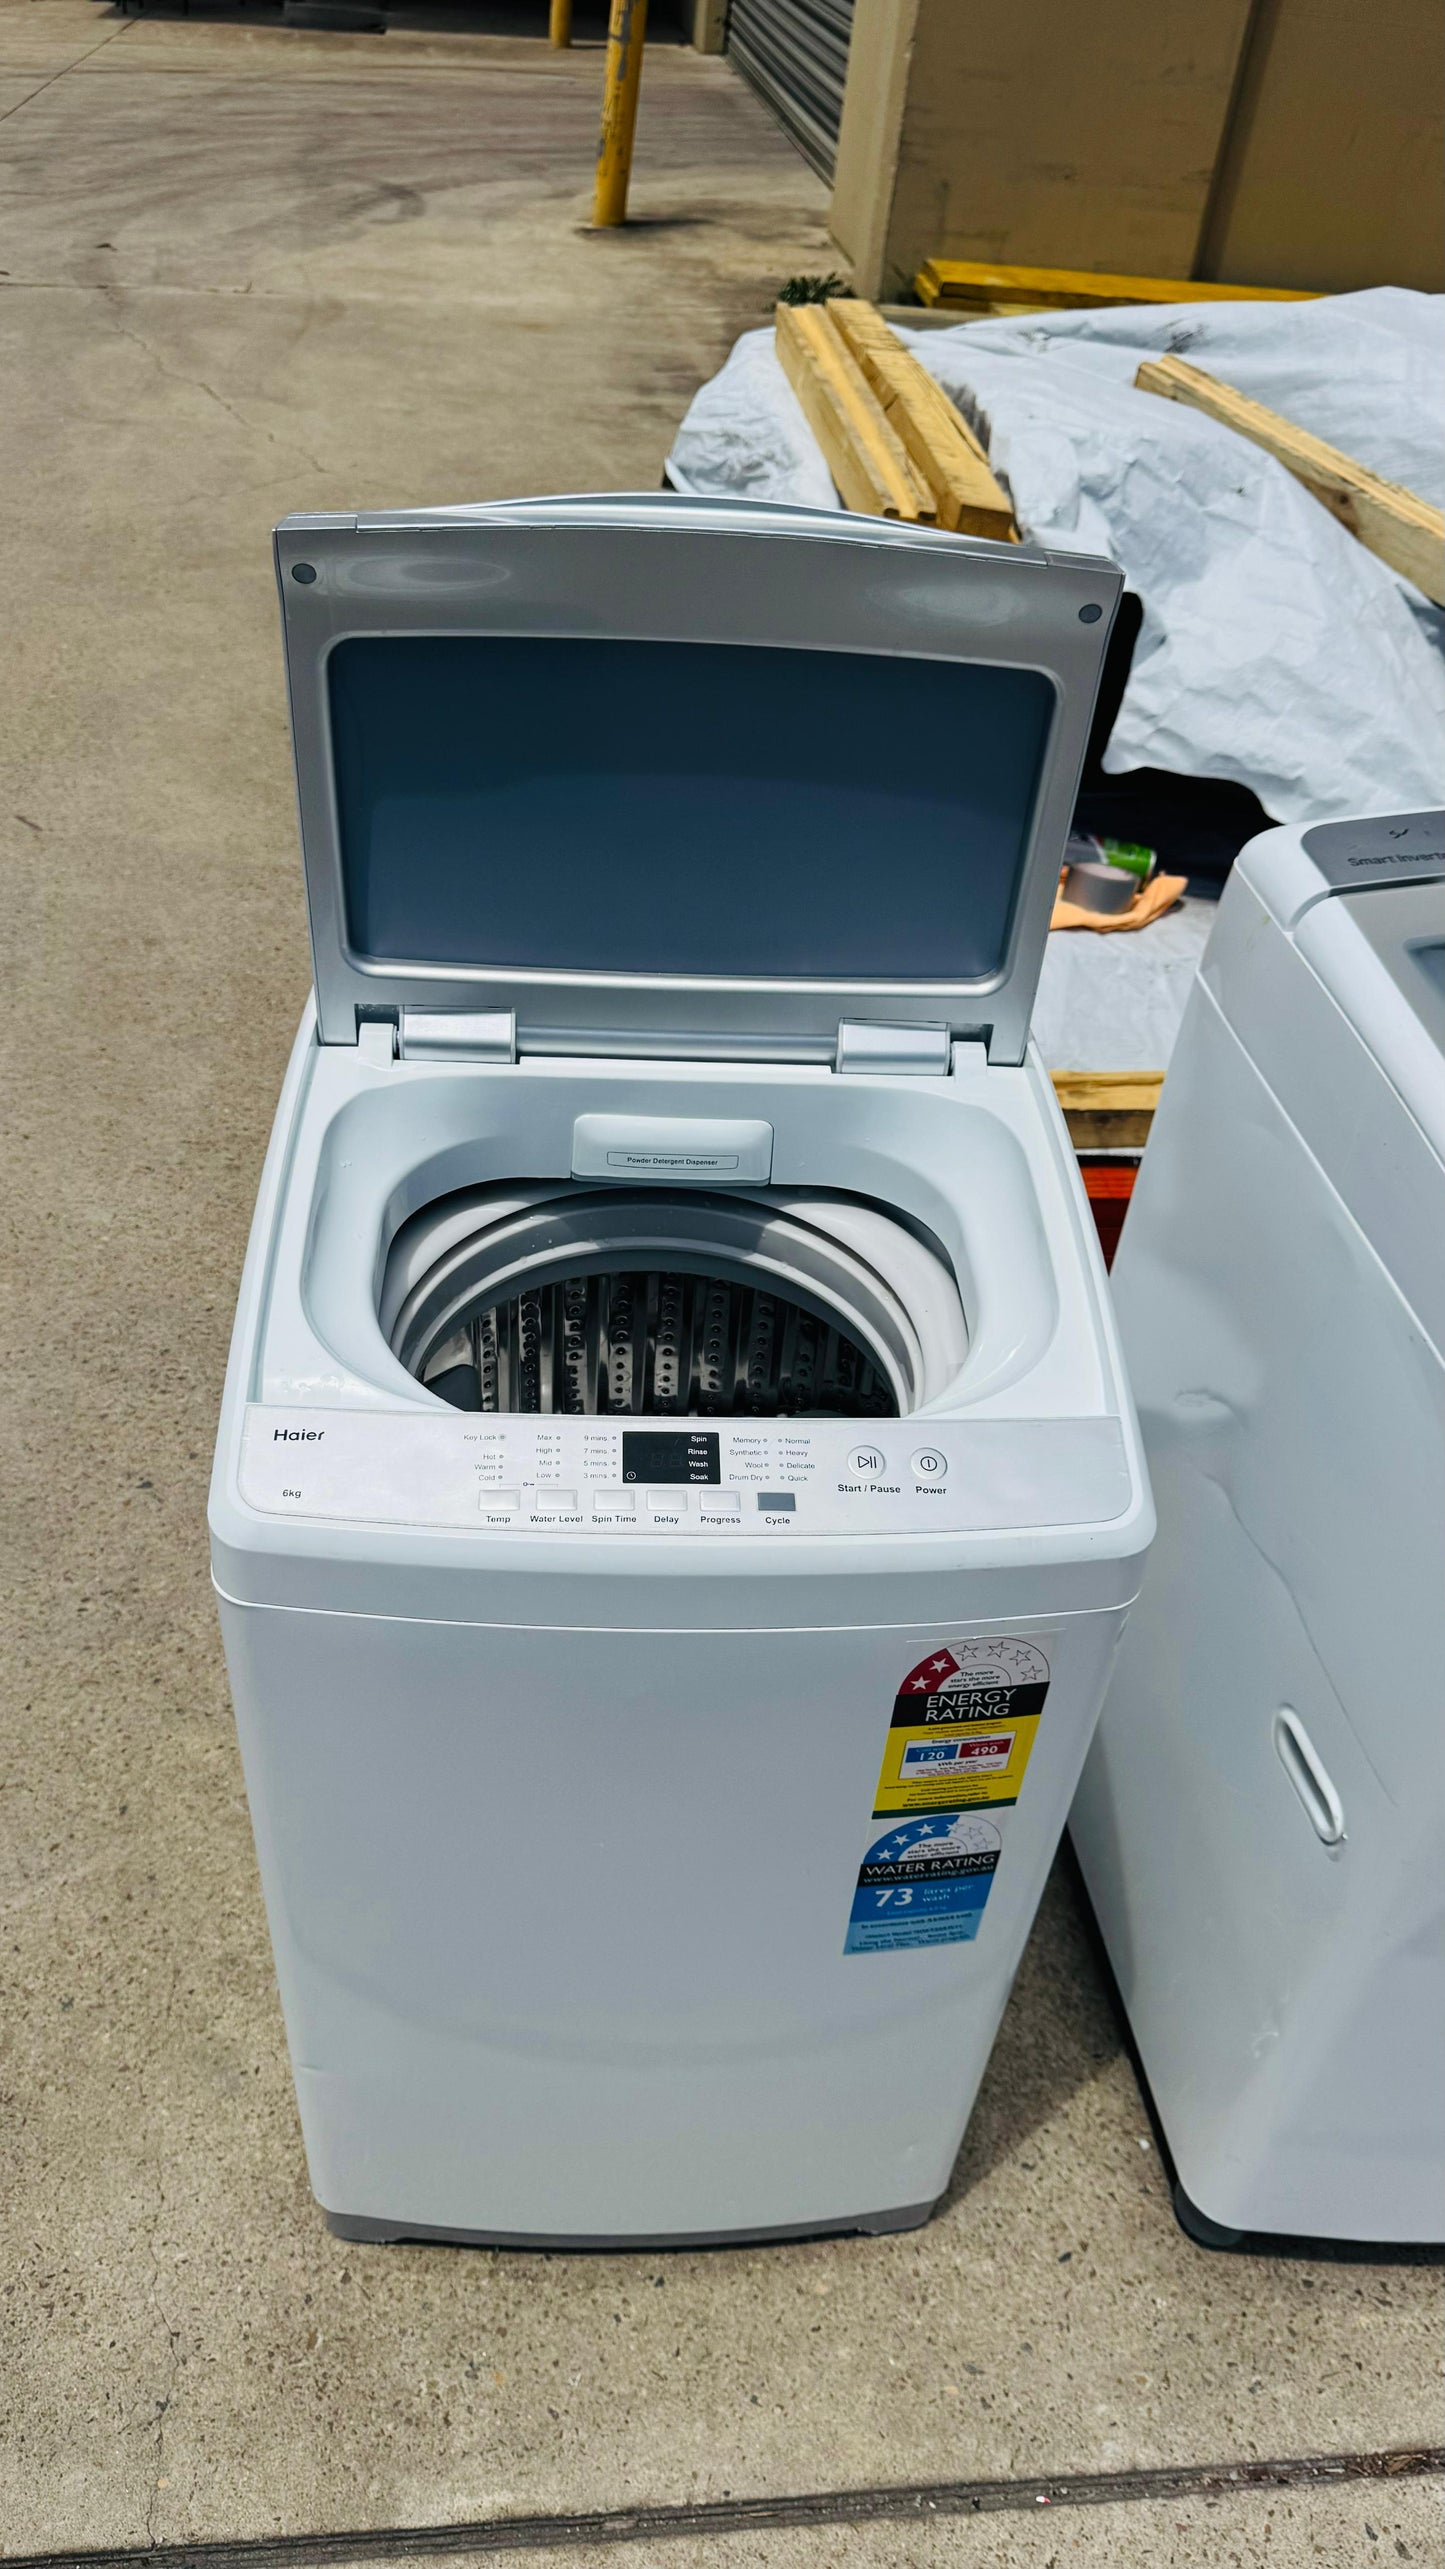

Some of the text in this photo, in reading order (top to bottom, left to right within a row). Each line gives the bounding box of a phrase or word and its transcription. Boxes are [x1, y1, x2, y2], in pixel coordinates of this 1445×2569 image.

[1348, 854, 1393, 867] Smart
[273, 1428, 325, 1442] Haier
[838, 1484, 861, 1492] Start
[871, 1485, 900, 1493] Pause
[916, 1486, 947, 1494] Power
[282, 1488, 302, 1499] 6kg
[592, 1516, 612, 1524] Spin
[654, 1516, 679, 1524] Delay
[700, 1517, 741, 1525] Progress
[765, 1517, 791, 1525] Cycle
[927, 1689, 1017, 1708] ENERGY
[925, 1704, 1011, 1721] RATING
[971, 1746, 998, 1755] 490
[920, 1752, 944, 1760] 120
[866, 1854, 995, 1875] WATER RATING
[875, 1888, 914, 1907] 73
